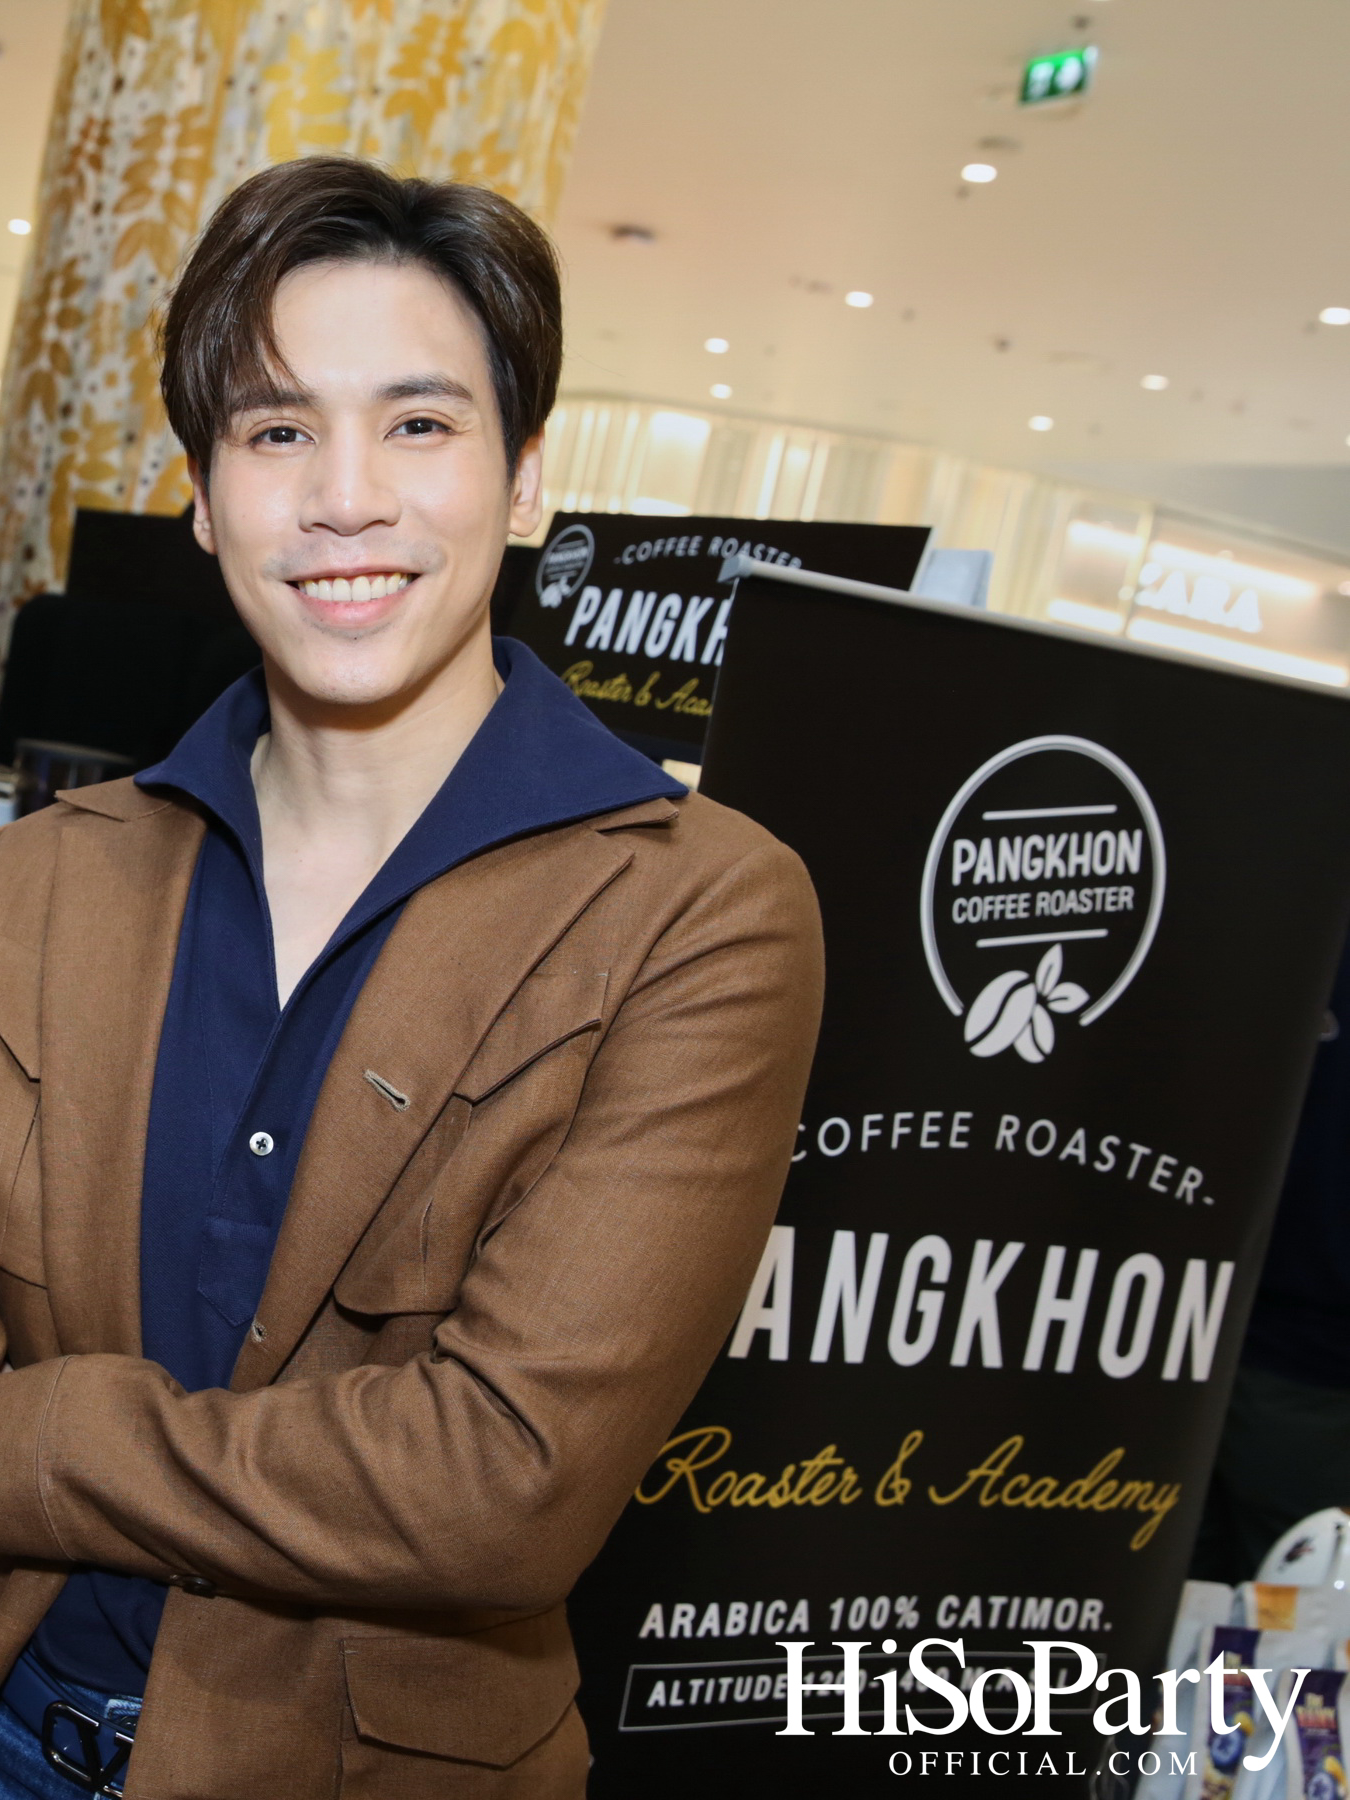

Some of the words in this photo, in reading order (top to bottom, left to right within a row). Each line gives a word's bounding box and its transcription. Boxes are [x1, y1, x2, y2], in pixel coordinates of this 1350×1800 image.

[952, 828, 1143, 886] PANGKHON
[952, 892, 1032, 924] COFFEE
[1035, 886, 1135, 918] ROASTER
[635, 1426, 863, 1513] Roaster
[875, 1430, 924, 1507] &
[928, 1435, 1181, 1551] Academy
[638, 1600, 810, 1640] ARABICA
[829, 1597, 921, 1632] 100%
[935, 1595, 1113, 1632] CATIMOR.
[646, 1673, 789, 1708] ALTITUDE
